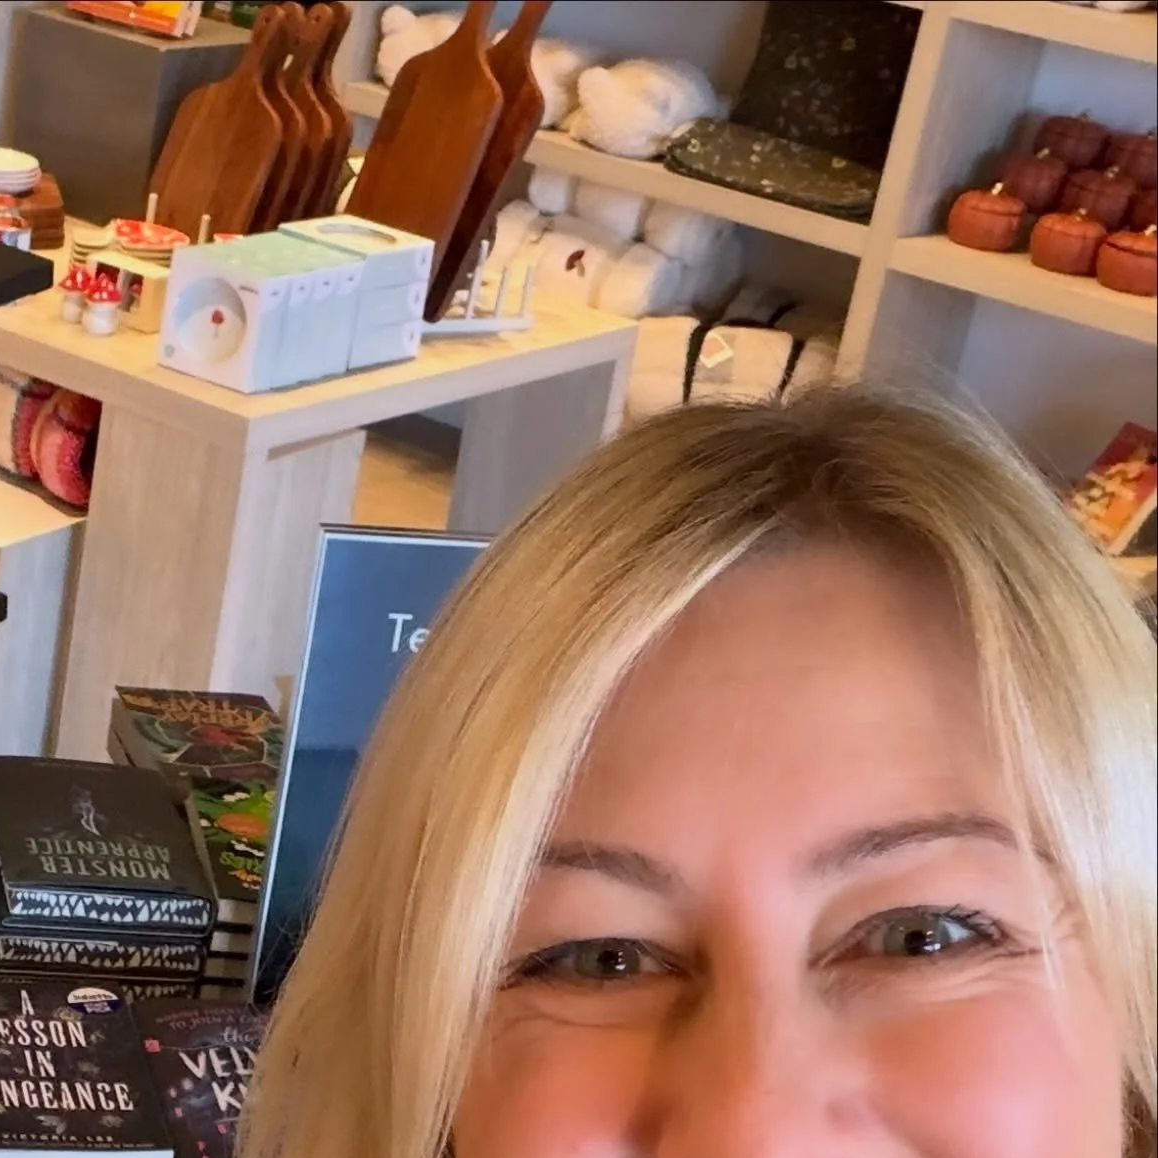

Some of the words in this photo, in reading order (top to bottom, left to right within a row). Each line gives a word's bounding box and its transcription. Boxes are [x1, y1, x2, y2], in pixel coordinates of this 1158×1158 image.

[388, 613, 430, 653] Te
[25, 837, 170, 863] APPRENTICE
[40, 856, 171, 880] MONSTER
[20, 989, 35, 1016] A
[24, 1049, 56, 1078] IN
